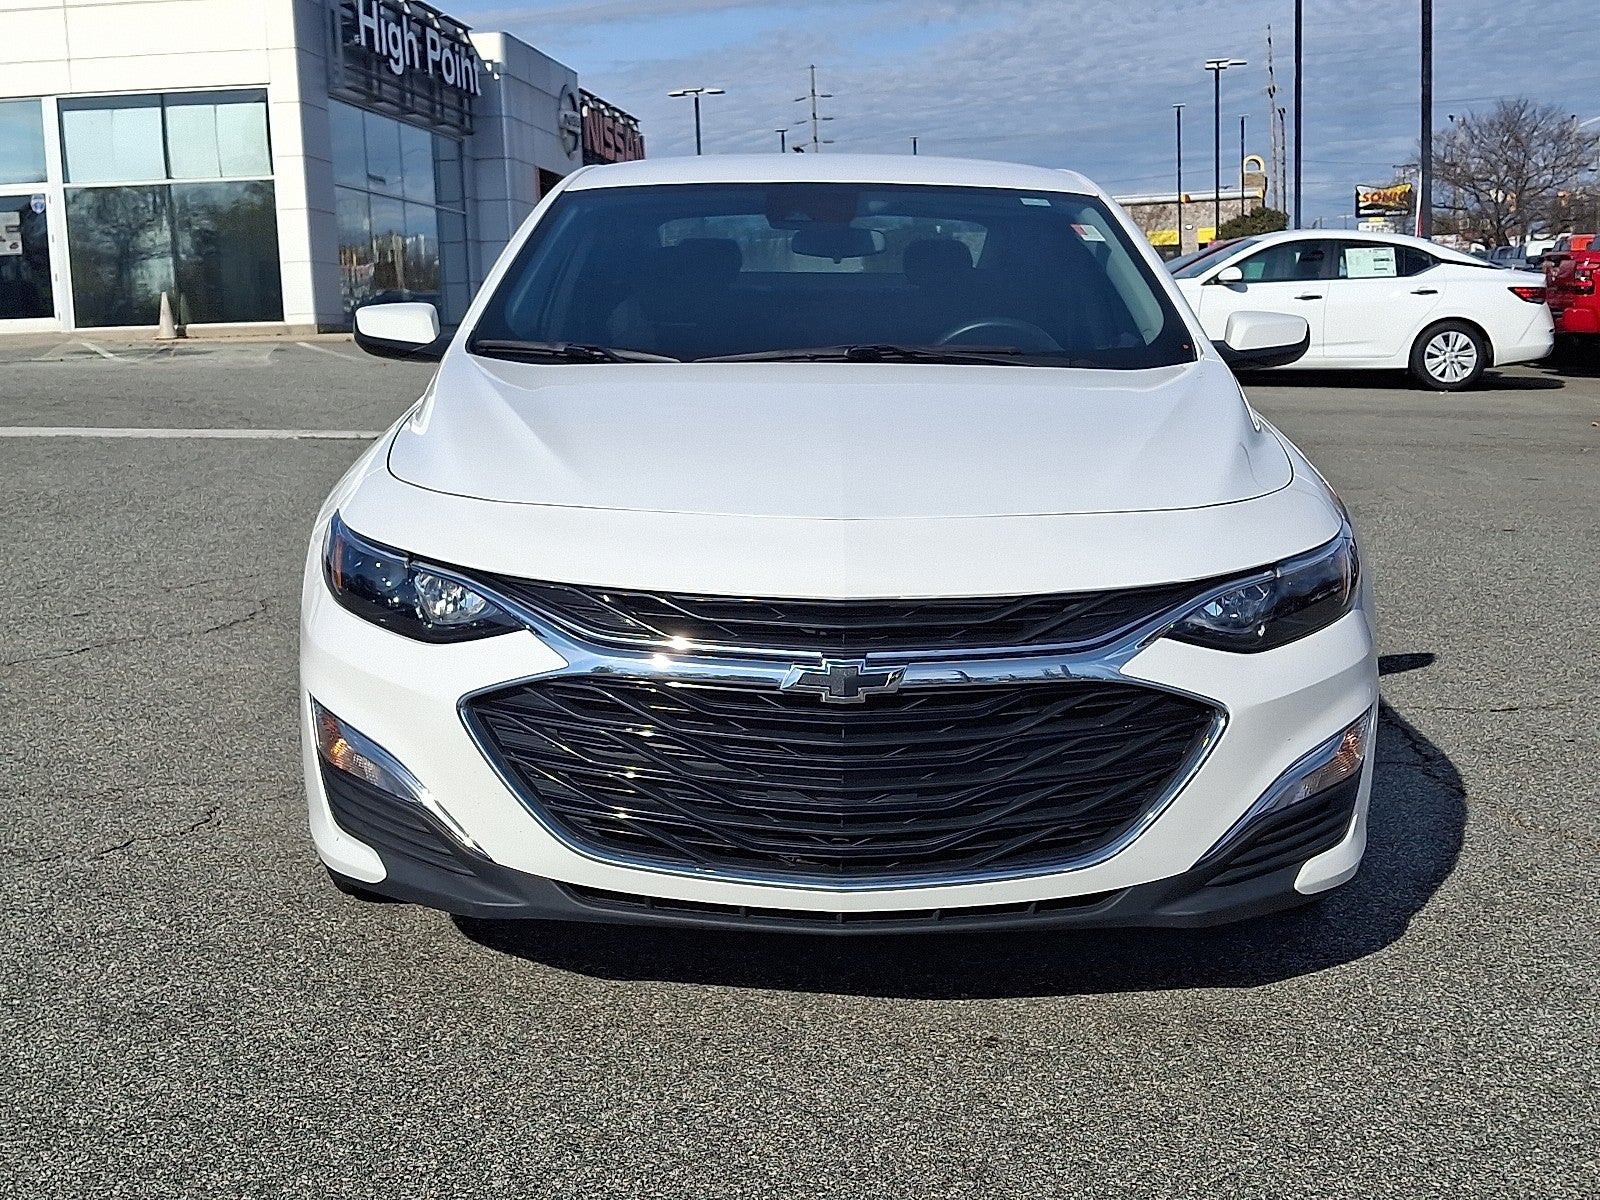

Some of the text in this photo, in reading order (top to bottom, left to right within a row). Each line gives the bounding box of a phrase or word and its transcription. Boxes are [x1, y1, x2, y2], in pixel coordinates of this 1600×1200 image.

[357, 0, 481, 96] High Point
[583, 107, 645, 161] NISSAN
[1362, 191, 1409, 203] SONIC
